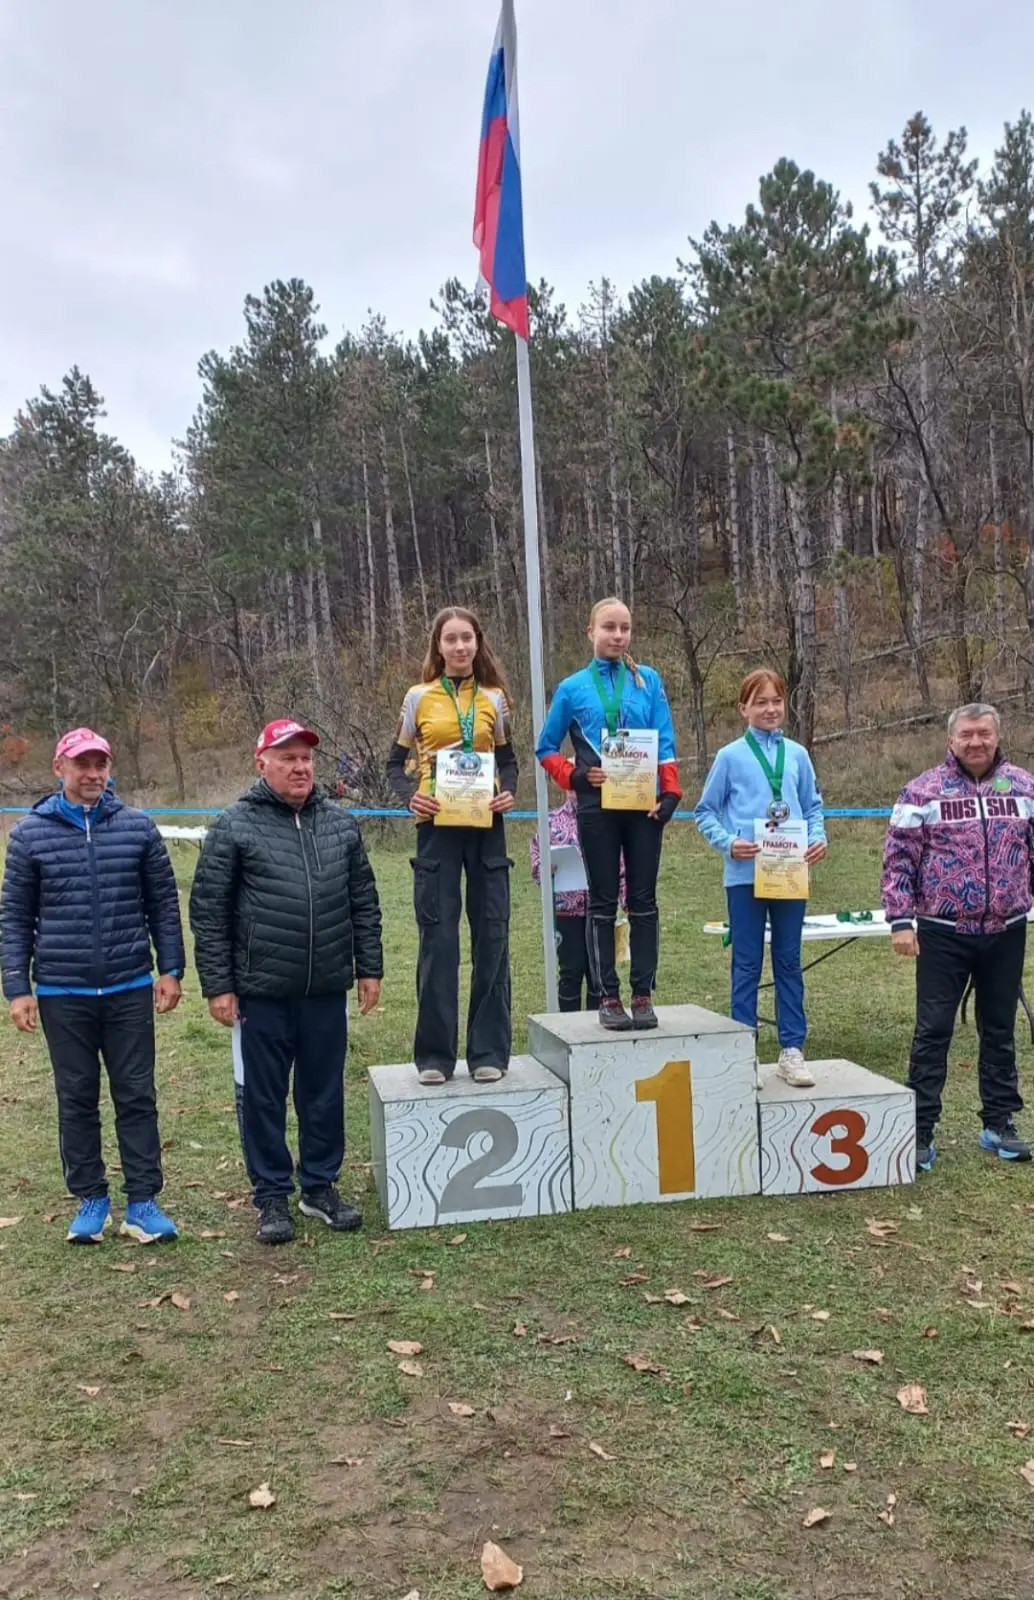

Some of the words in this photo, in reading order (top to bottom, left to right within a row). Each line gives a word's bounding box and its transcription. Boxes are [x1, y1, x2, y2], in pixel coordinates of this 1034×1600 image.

[762, 839, 799, 849] ГРАМОТА
[439, 1108, 523, 1213] 2
[635, 1061, 695, 1194] 1
[809, 1109, 869, 1185] 3
